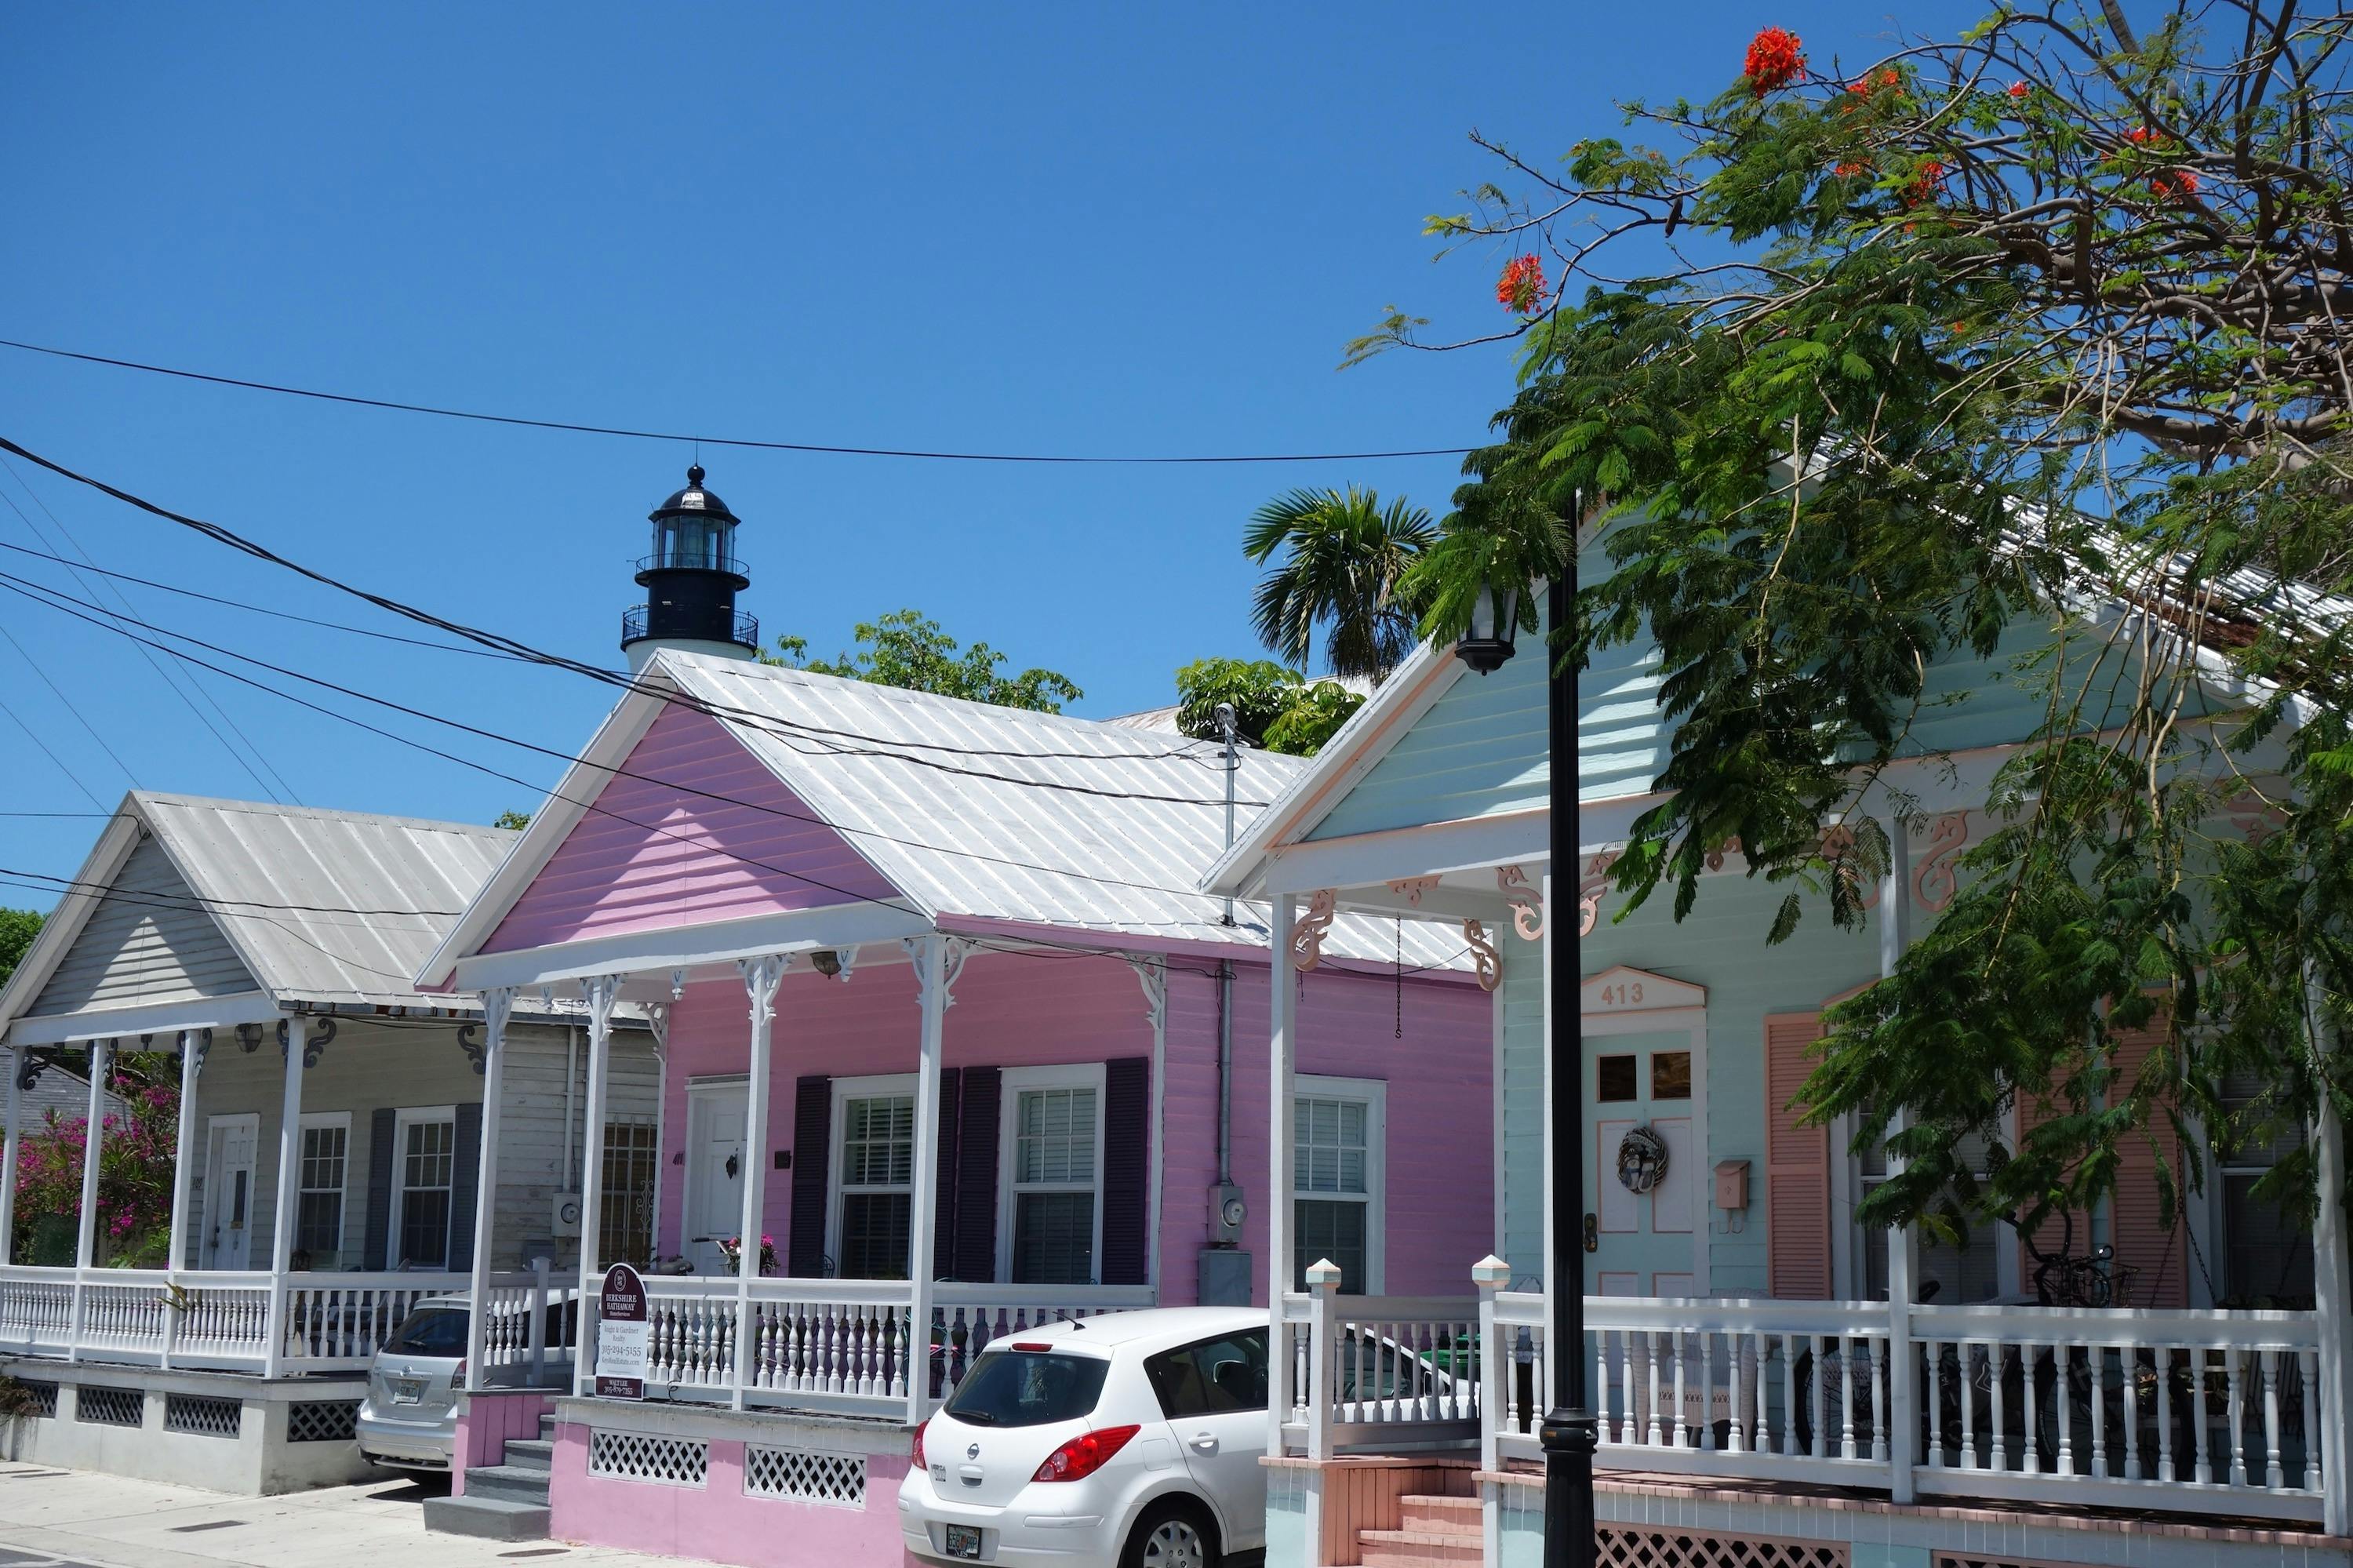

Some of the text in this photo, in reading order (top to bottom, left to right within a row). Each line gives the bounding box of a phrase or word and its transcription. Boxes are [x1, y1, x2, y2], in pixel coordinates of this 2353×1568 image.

[1602, 983, 1644, 1005] 413
[606, 1293, 637, 1303] BERKSHIRE
[606, 1302, 635, 1311] HATHAWAY
